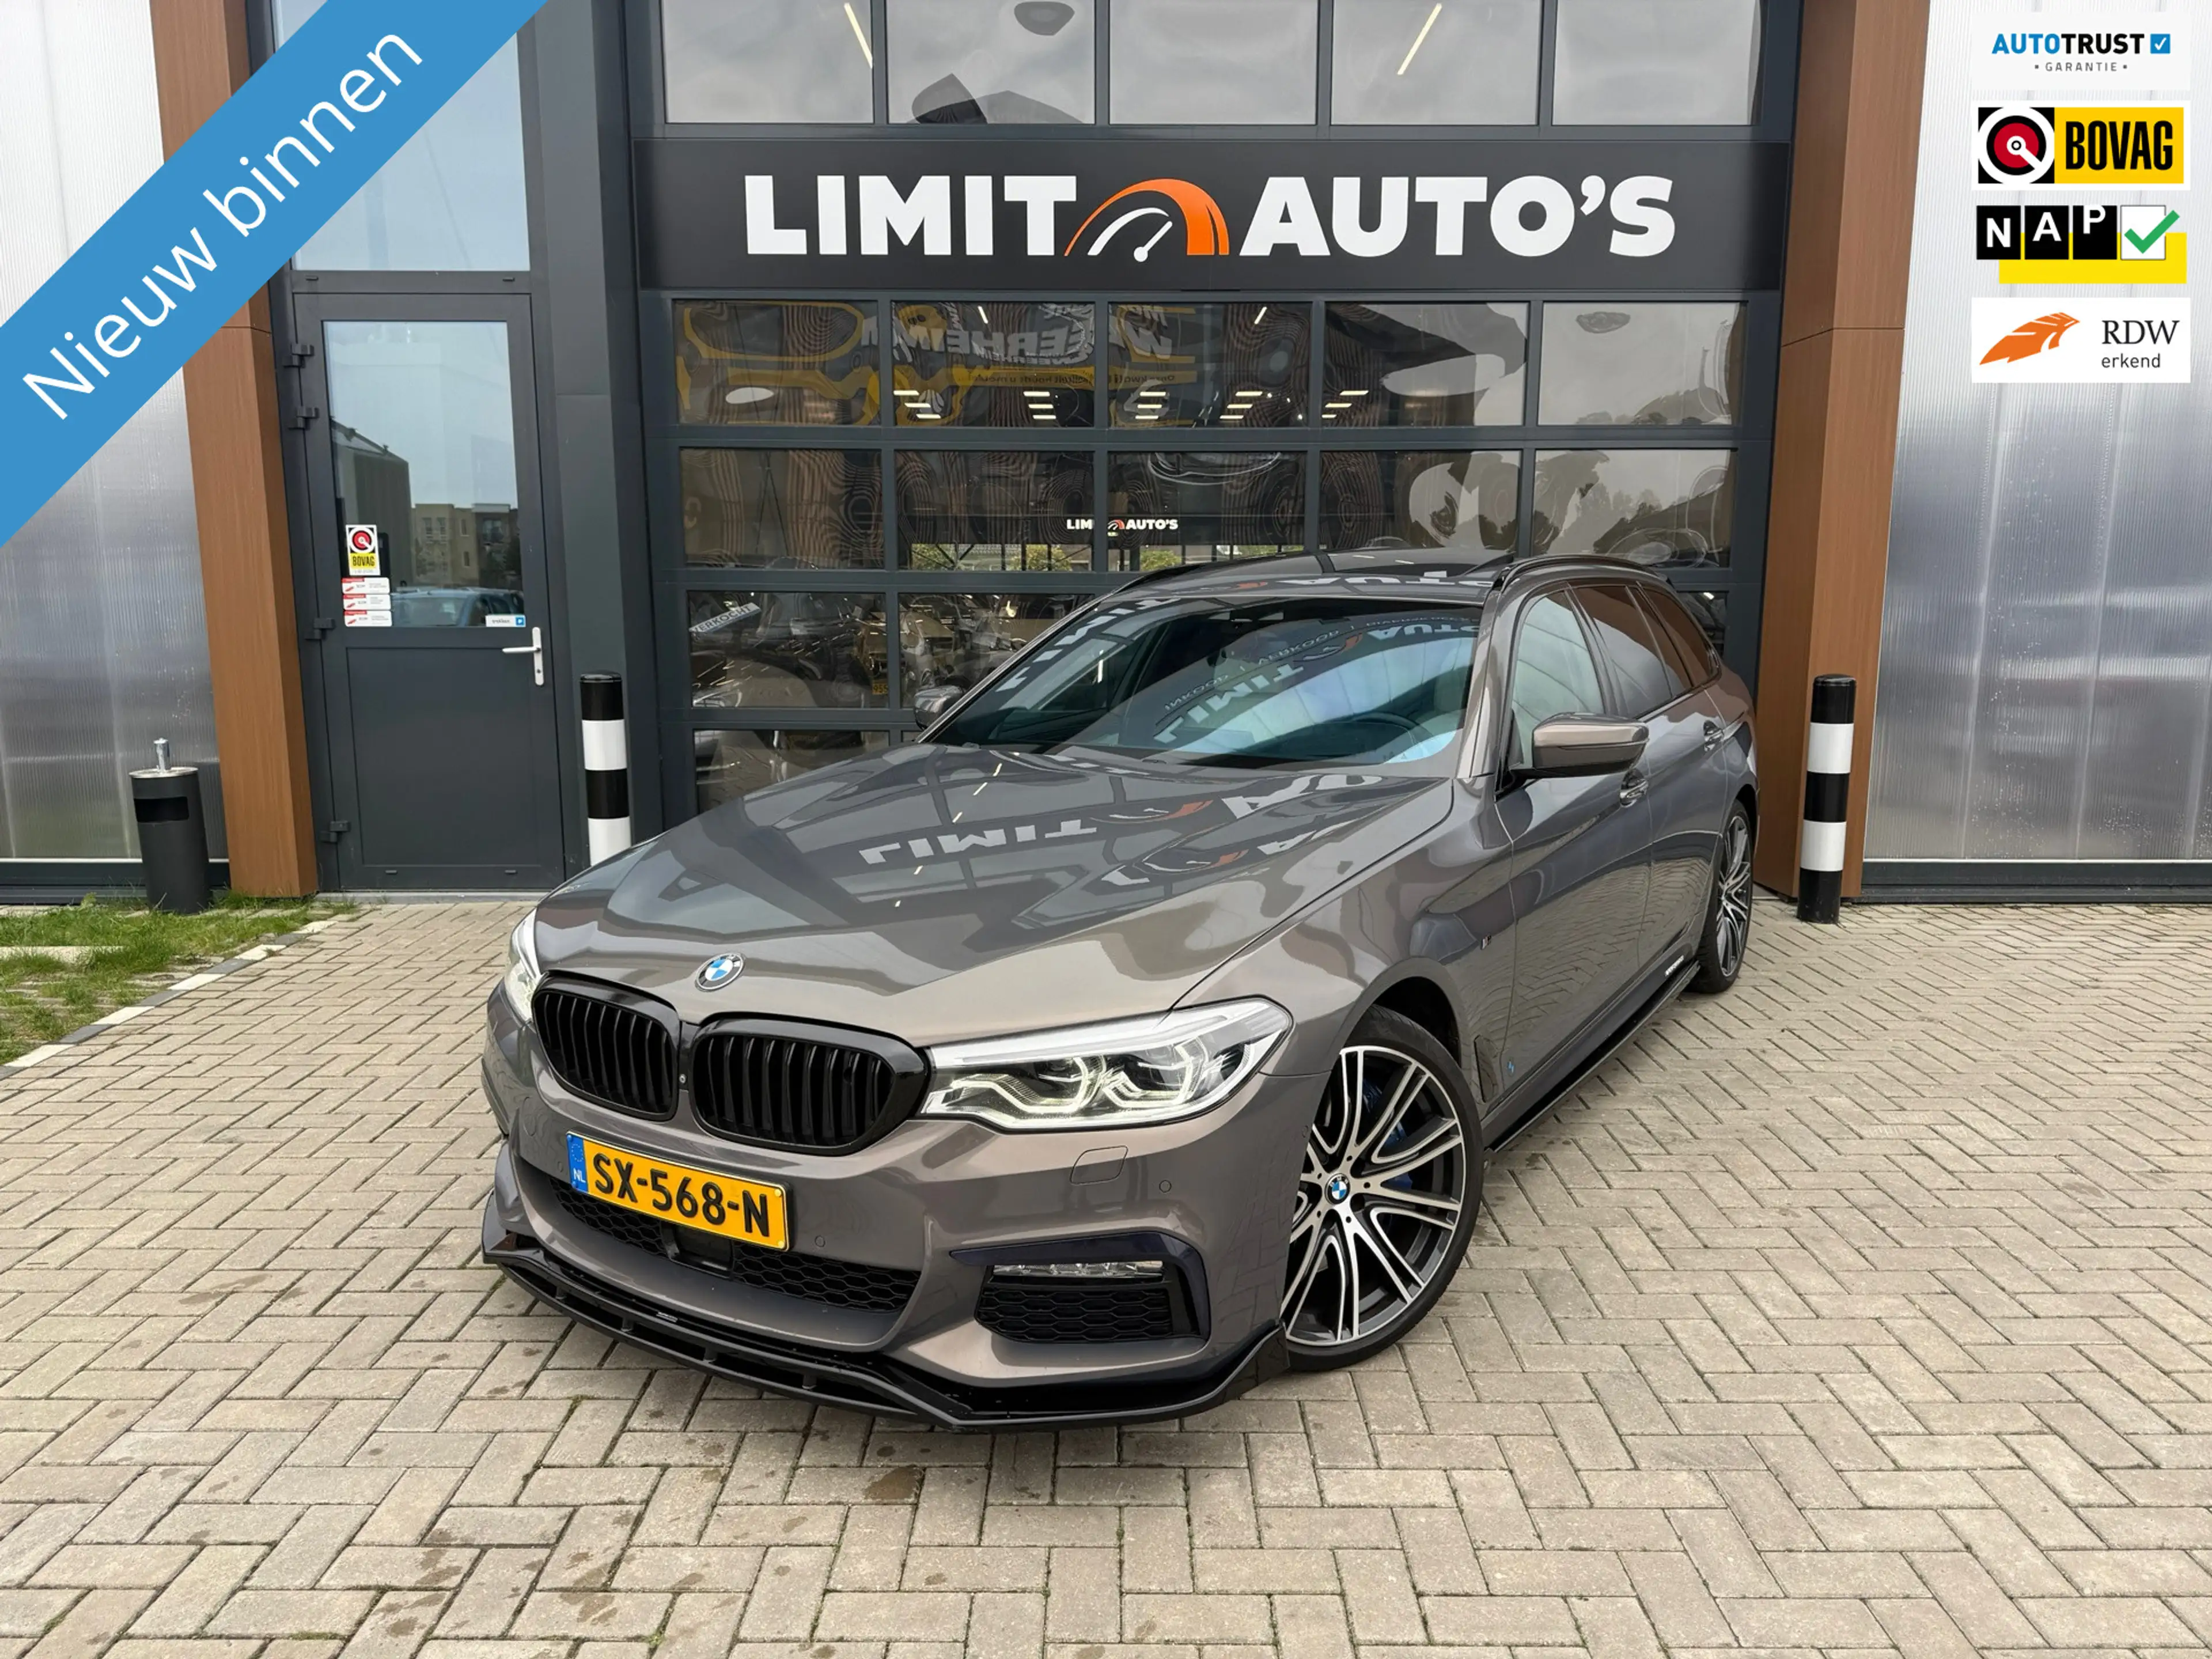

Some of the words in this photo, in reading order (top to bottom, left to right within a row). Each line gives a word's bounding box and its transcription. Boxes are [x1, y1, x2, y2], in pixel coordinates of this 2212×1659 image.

[744, 175, 1077, 255] LIMIT
[1239, 175, 1676, 257] AUTO'S
[1066, 519, 1093, 529] LIM
[1125, 519, 1179, 529] AUTO'S
[353, 556, 375, 566] BOVAG
[573, 1169, 586, 1183] NL
[593, 1153, 770, 1237] SX-568-N
